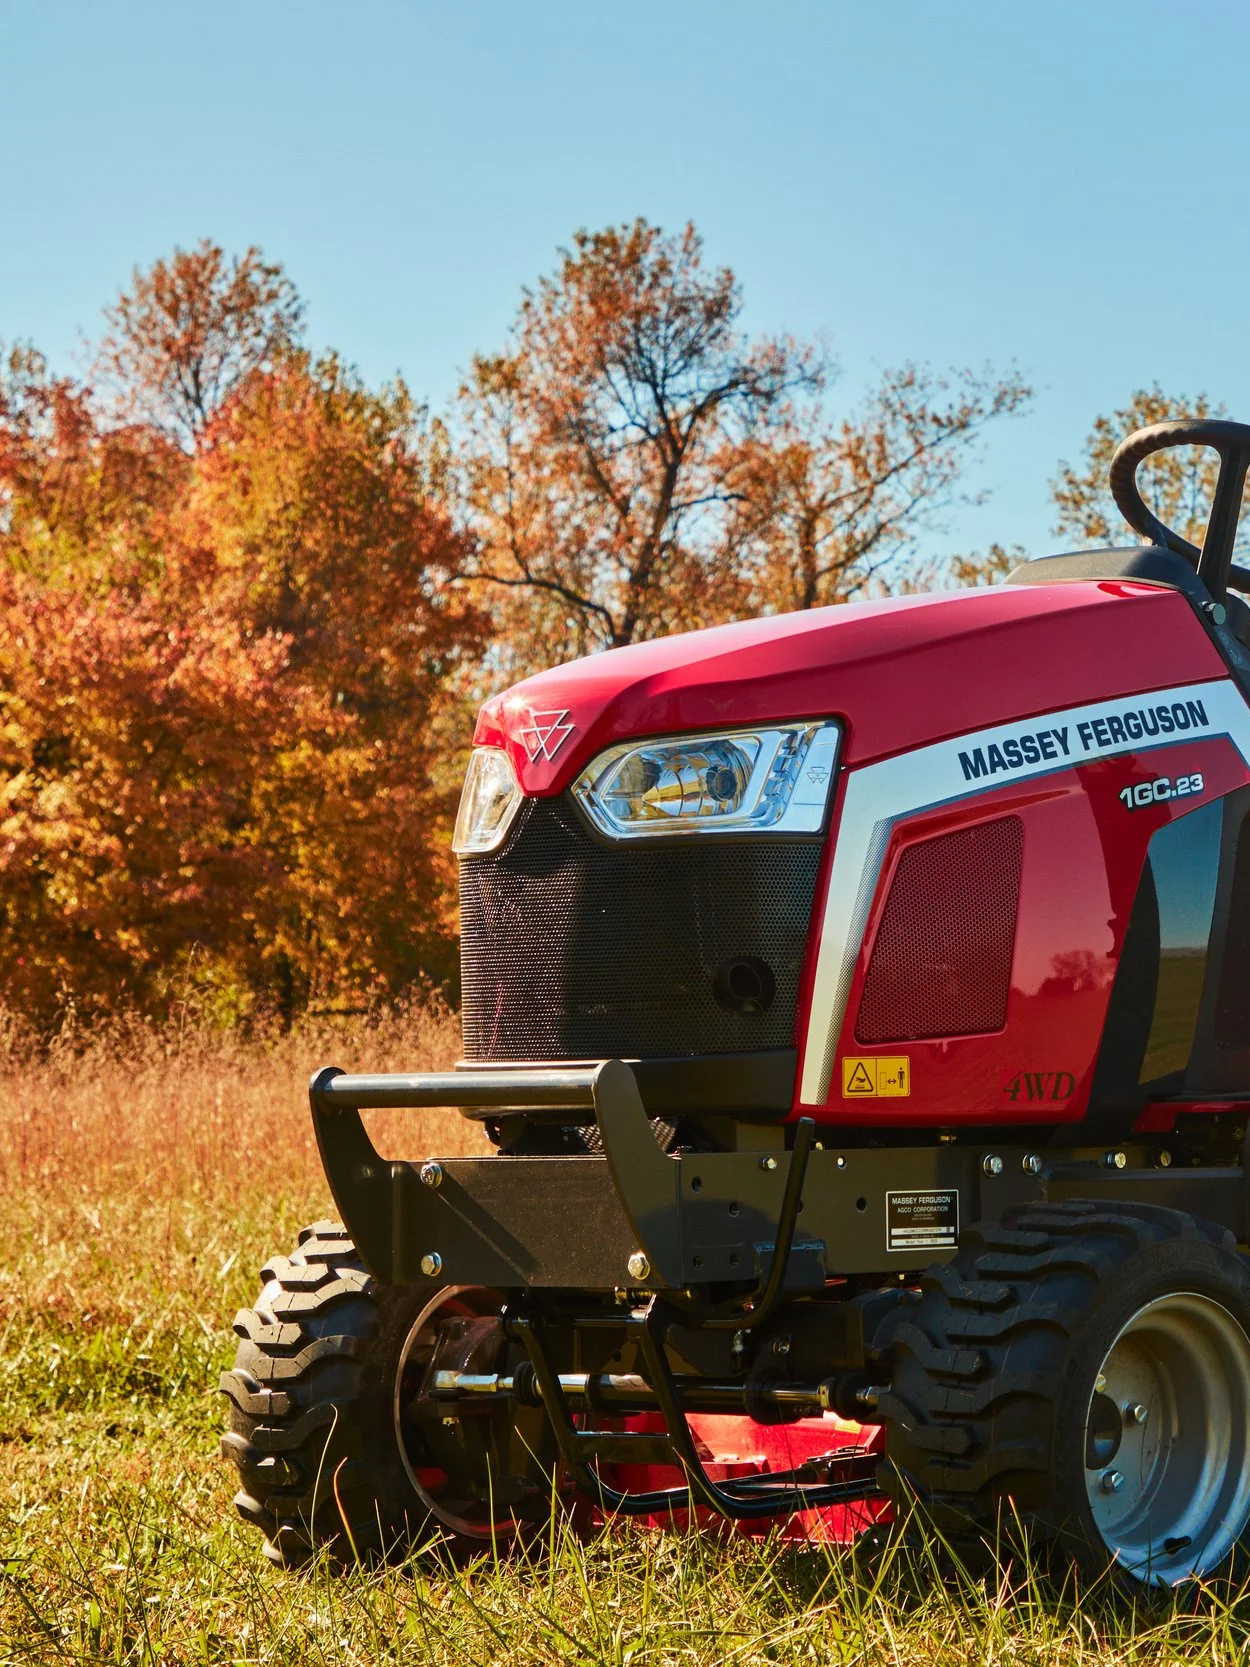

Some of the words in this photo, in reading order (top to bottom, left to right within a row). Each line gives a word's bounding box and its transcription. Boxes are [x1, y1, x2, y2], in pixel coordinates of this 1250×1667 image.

[958, 727, 1072, 780] MASSEY
[1076, 700, 1209, 751] FERGUSON
[1119, 774, 1204, 810] 1GC.23
[1003, 1071, 1075, 1101] 4WD
[913, 1205, 948, 1213] CORPORATION
